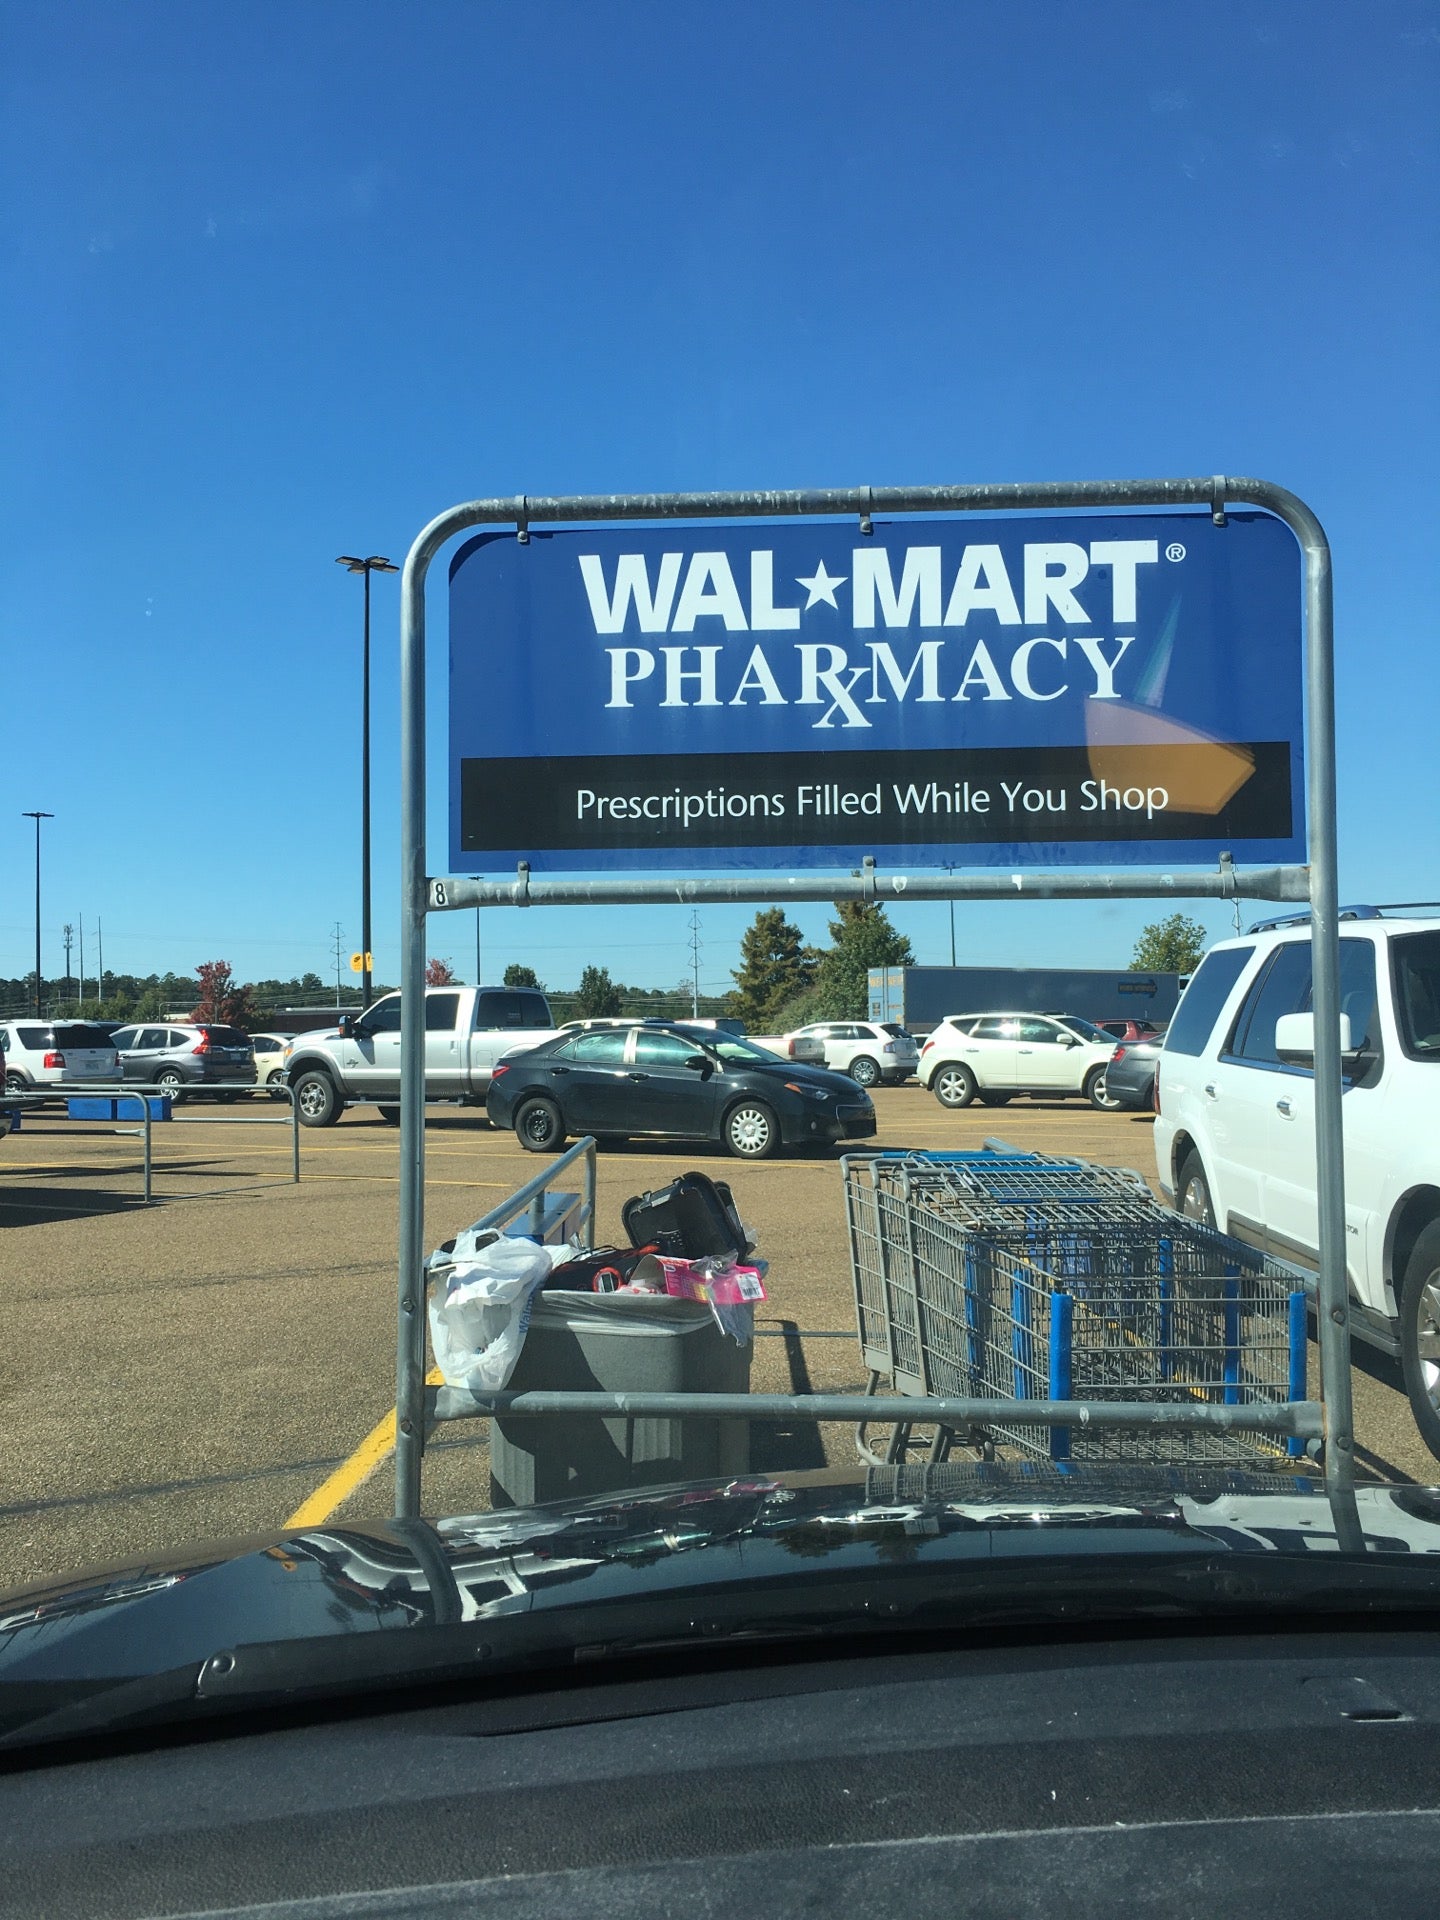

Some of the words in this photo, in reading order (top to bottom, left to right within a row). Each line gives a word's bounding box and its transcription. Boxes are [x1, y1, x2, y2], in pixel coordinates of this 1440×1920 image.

[577, 787, 785, 828] Prescriptions
[798, 783, 882, 816] Filled
[892, 781, 990, 814] While
[1001, 781, 1067, 812] You
[1080, 779, 1169, 820] Shop
[435, 882, 446, 905] 8
